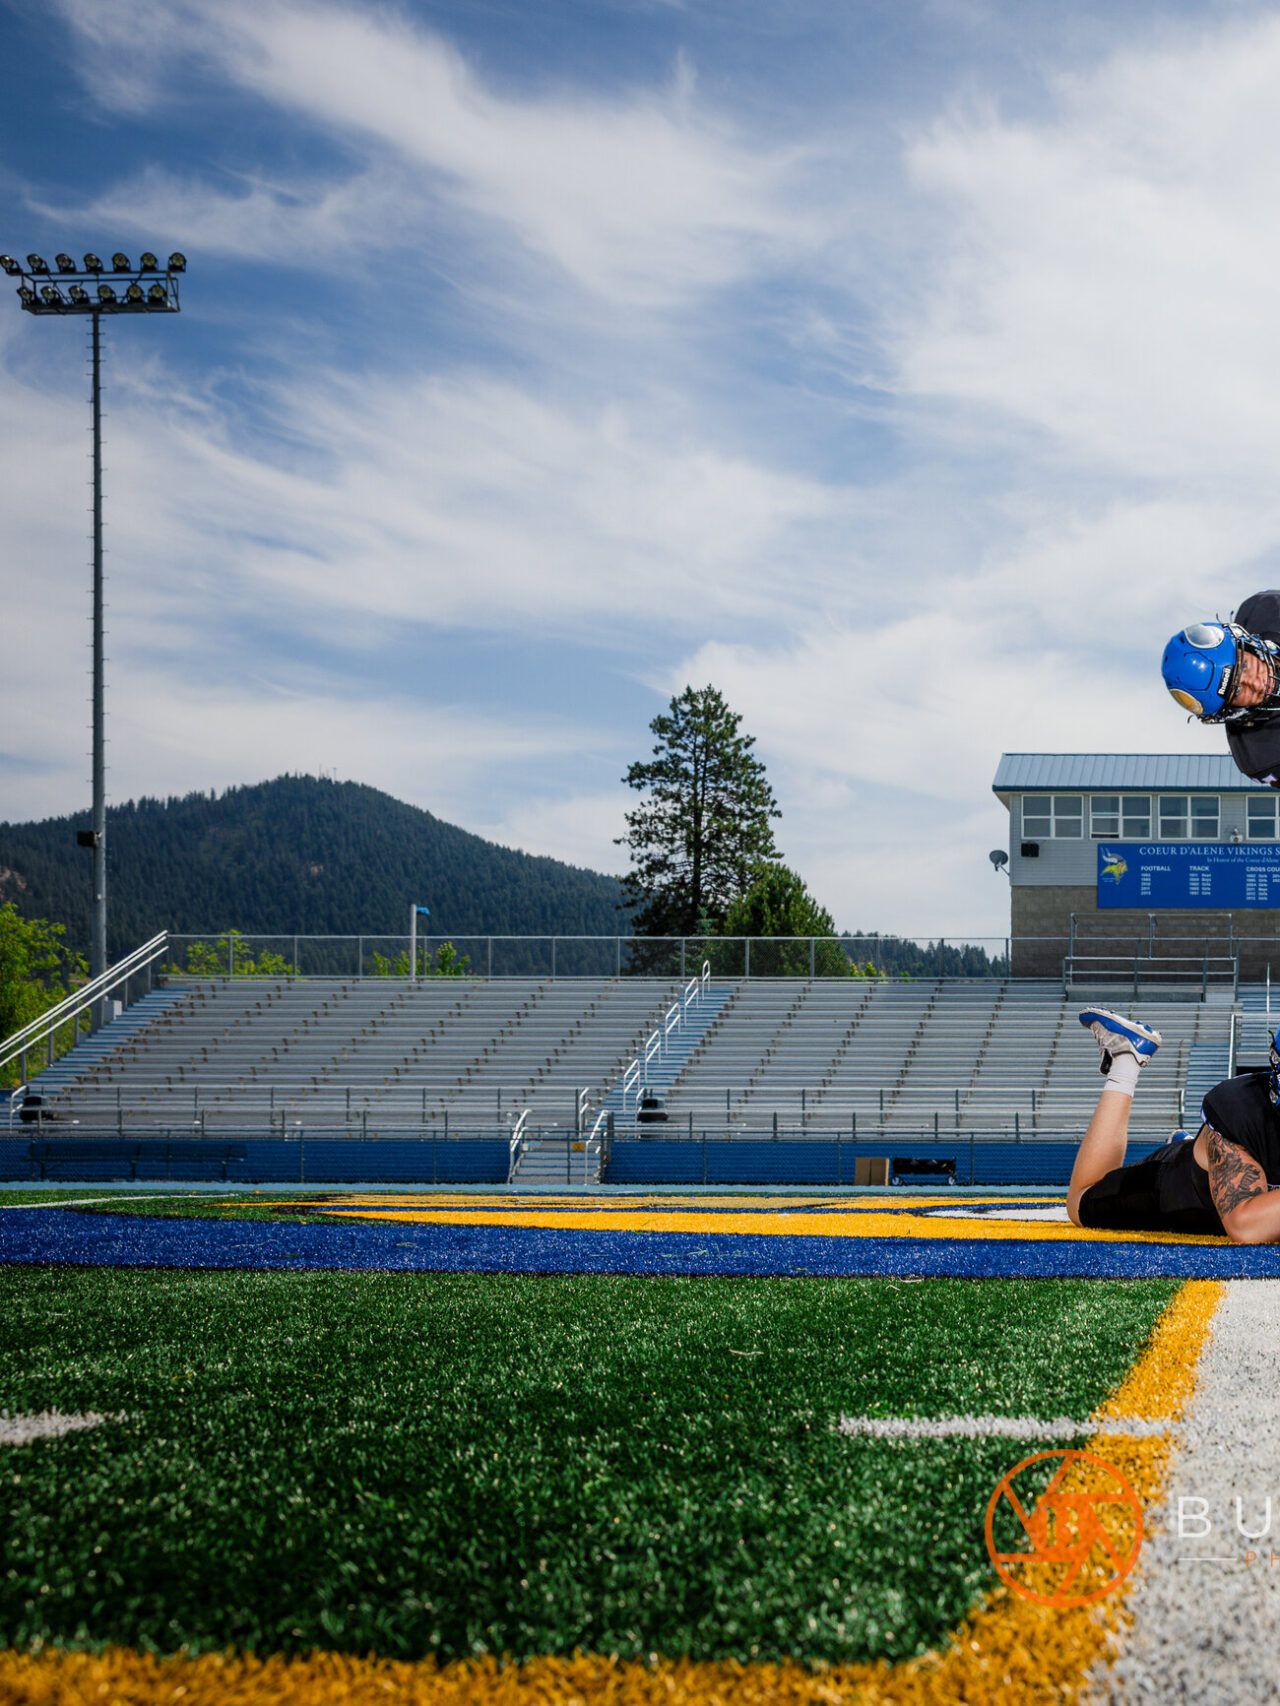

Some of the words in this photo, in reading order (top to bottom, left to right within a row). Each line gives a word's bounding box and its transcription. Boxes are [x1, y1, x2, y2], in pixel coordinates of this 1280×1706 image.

[1139, 846, 1178, 856] COEUR
[1180, 846, 1225, 856] D'ALENE
[1227, 846, 1273, 856] VIKINGS
